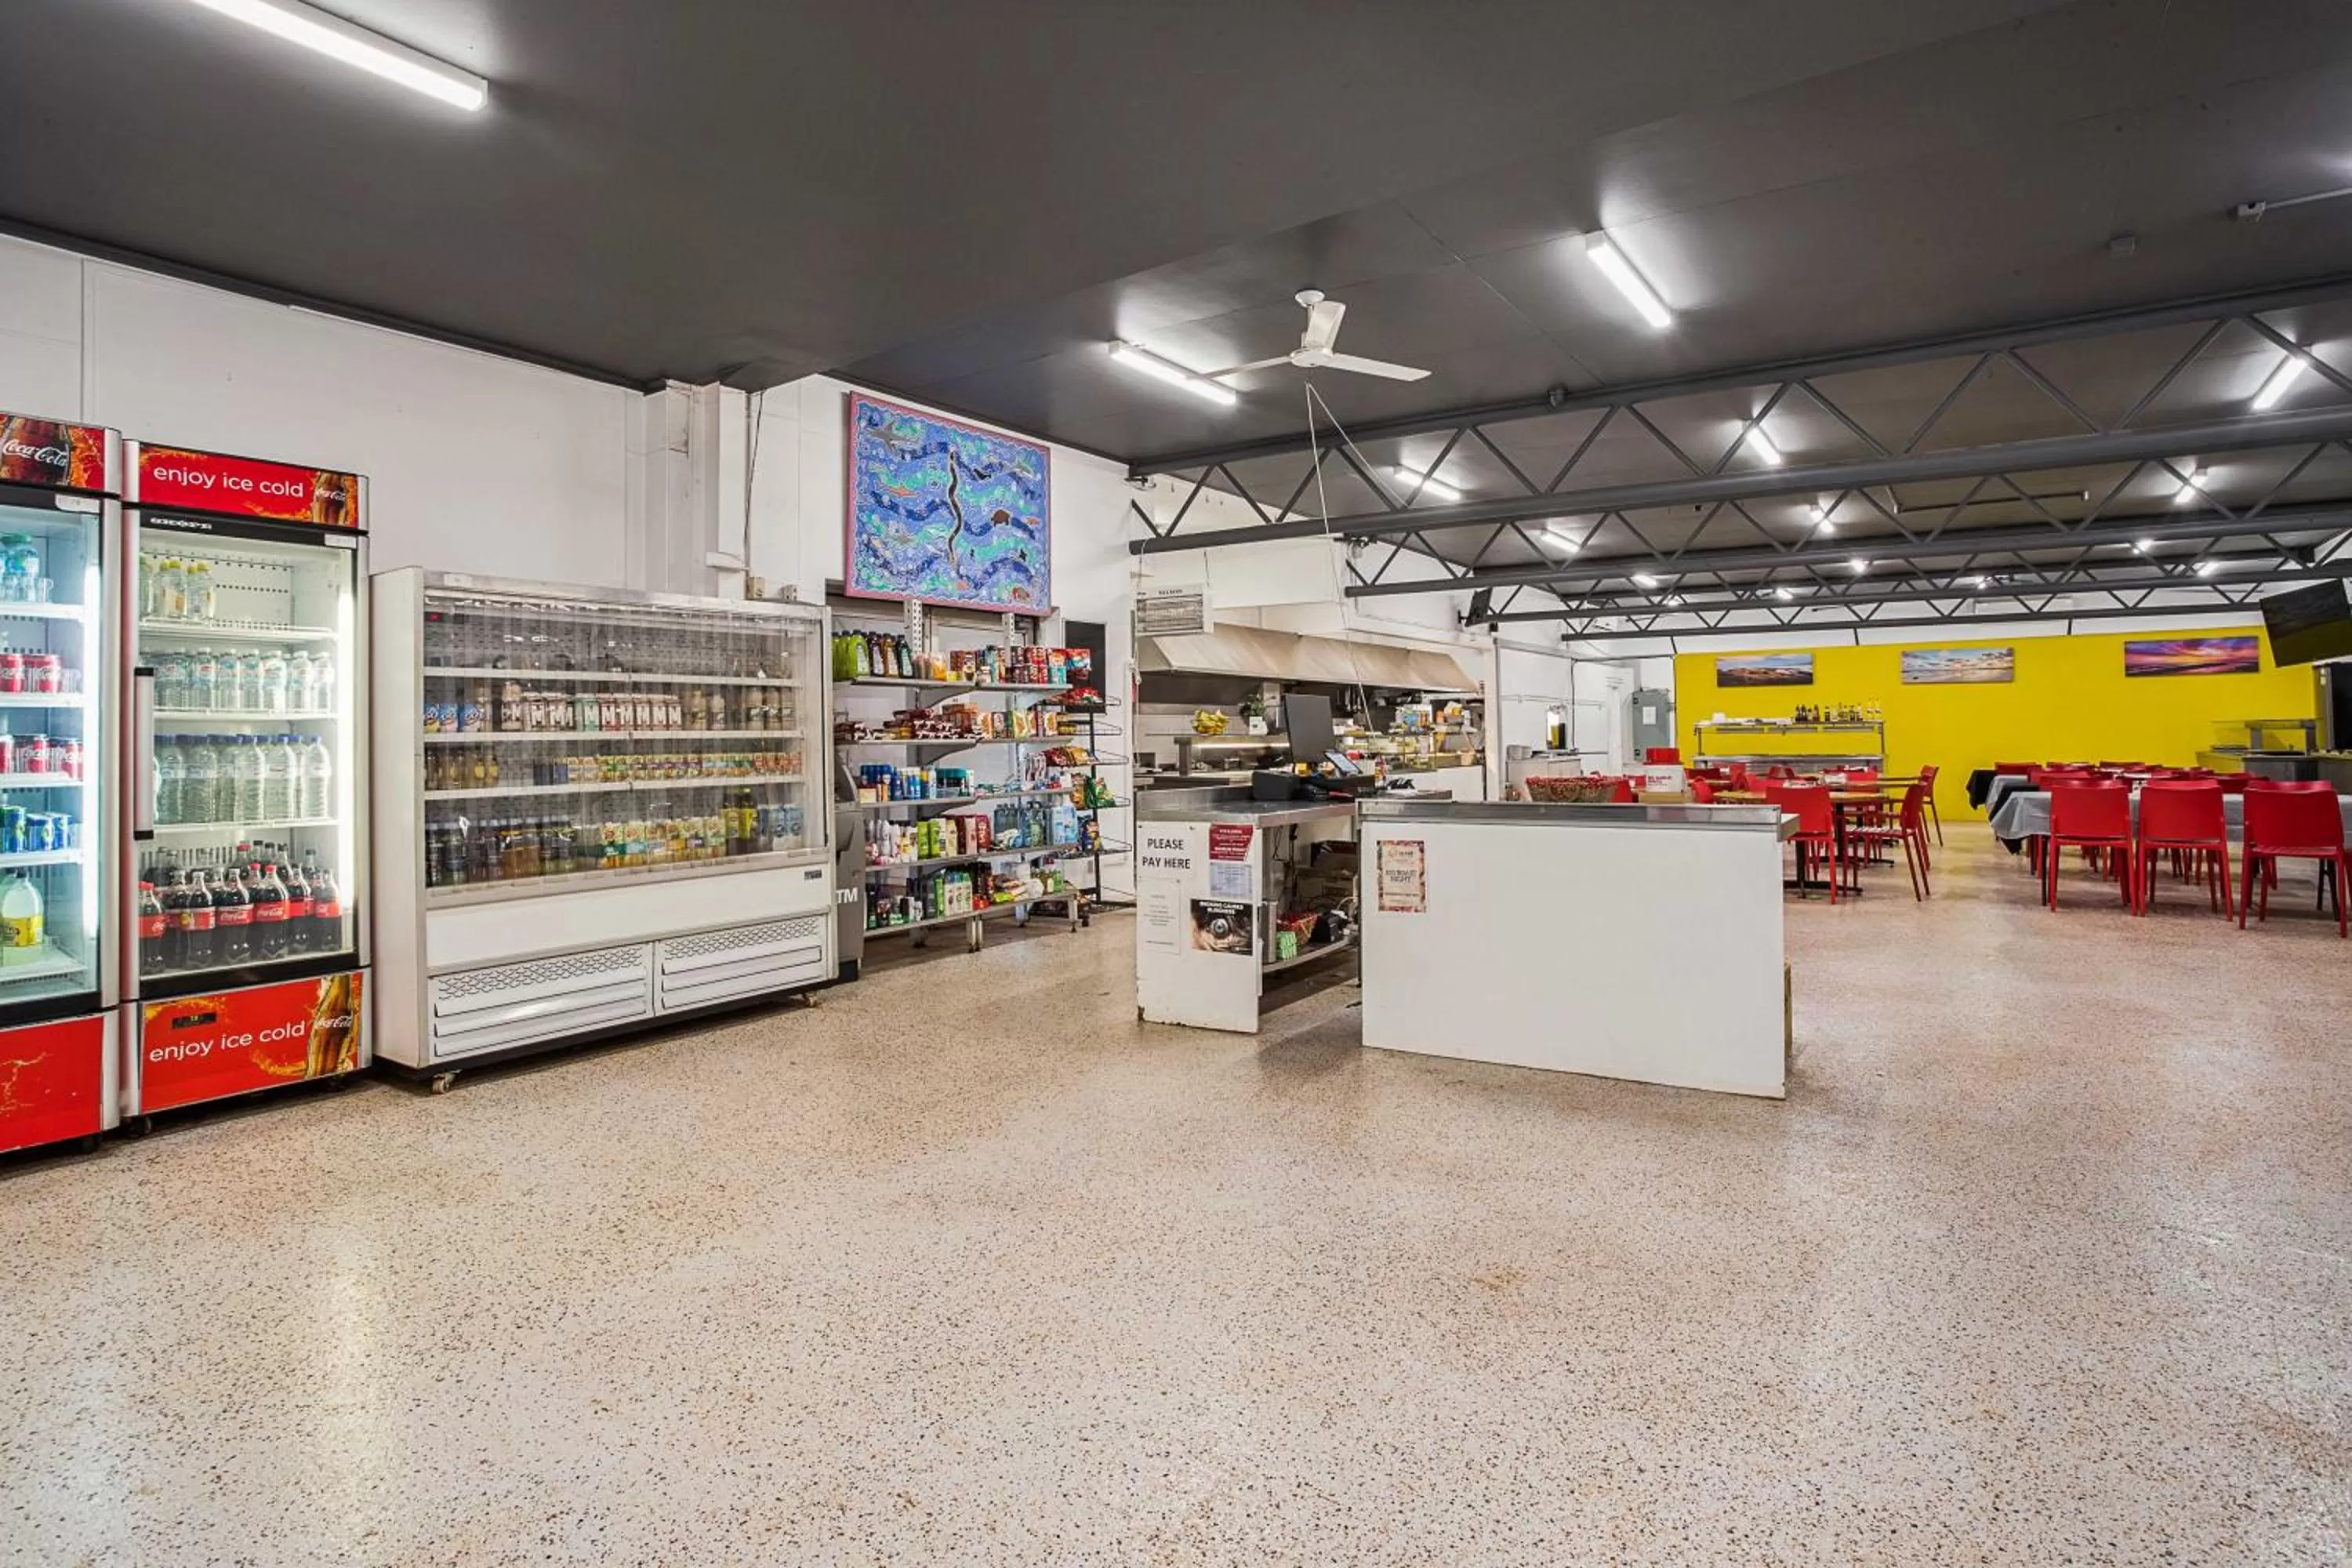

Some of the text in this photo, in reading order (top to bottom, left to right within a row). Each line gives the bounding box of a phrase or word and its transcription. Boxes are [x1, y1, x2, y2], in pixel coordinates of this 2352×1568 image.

[154, 466, 303, 498] enjoy ice cold
[1147, 838, 1184, 850] PLEASE
[1142, 856, 1191, 869] PAY HERE
[836, 887, 858, 904] TM
[150, 1020, 305, 1062] enjoy ice cold
